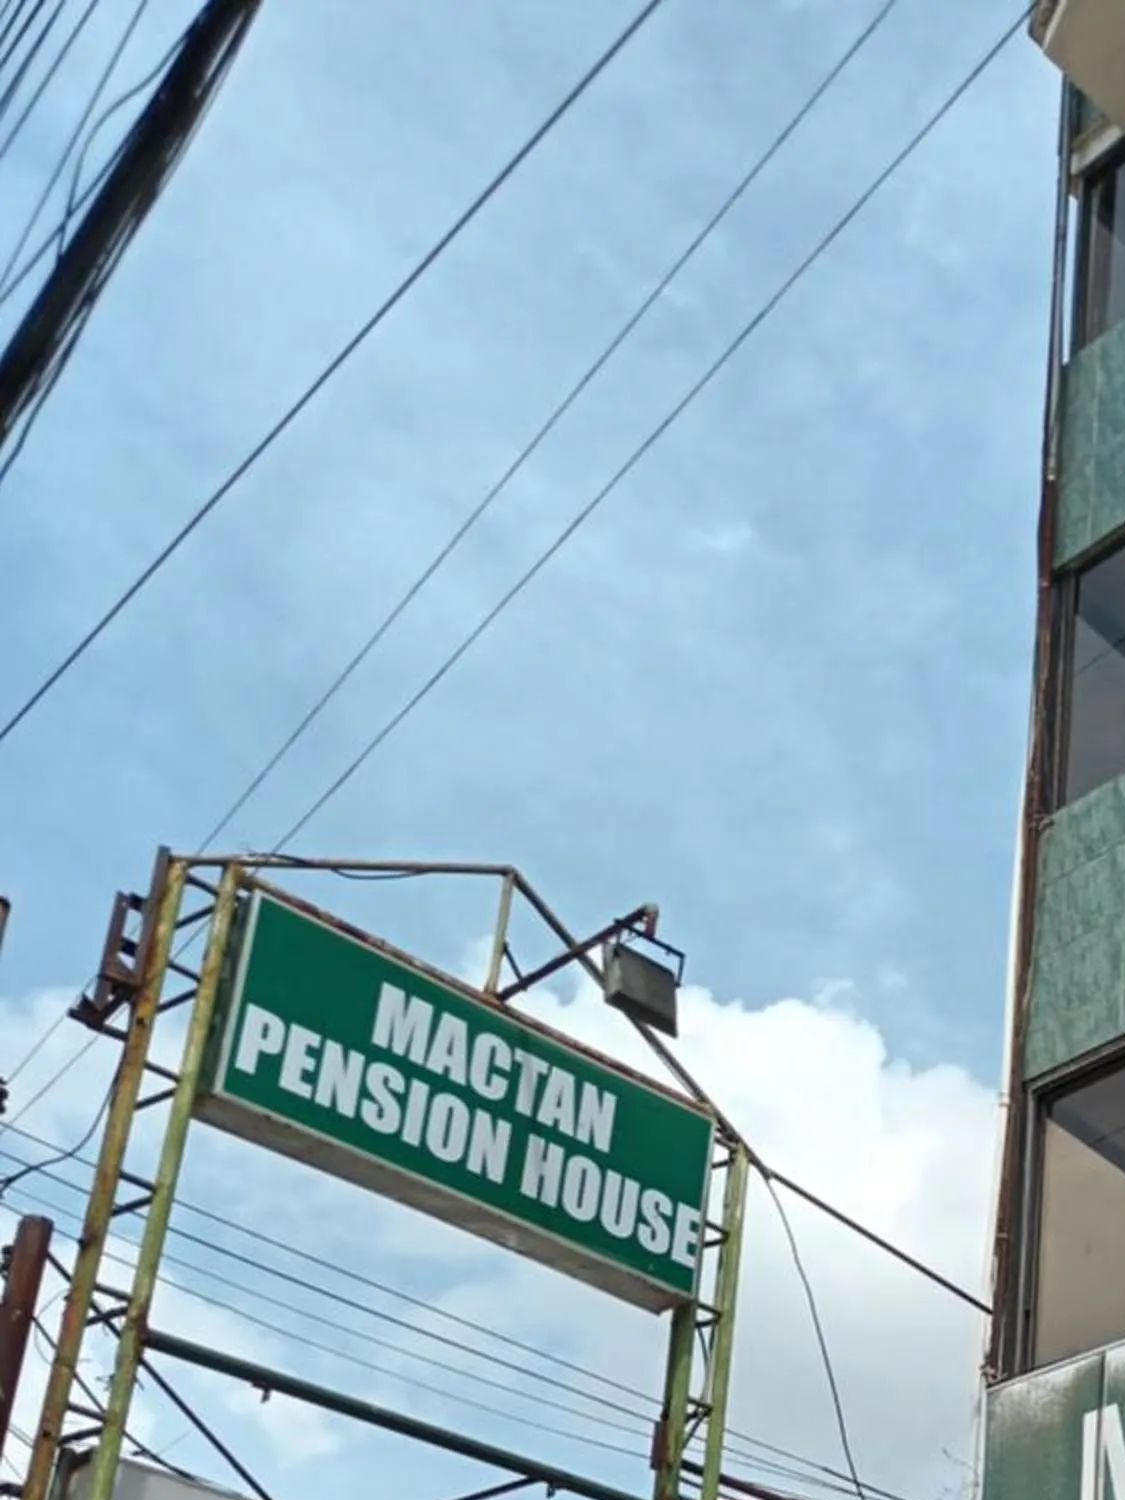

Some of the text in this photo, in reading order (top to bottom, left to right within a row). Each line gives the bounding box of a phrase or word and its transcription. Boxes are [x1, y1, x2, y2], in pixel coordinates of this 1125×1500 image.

[235, 1002, 702, 1270] PENSION HOUSE
[371, 981, 618, 1154] MACTAN
